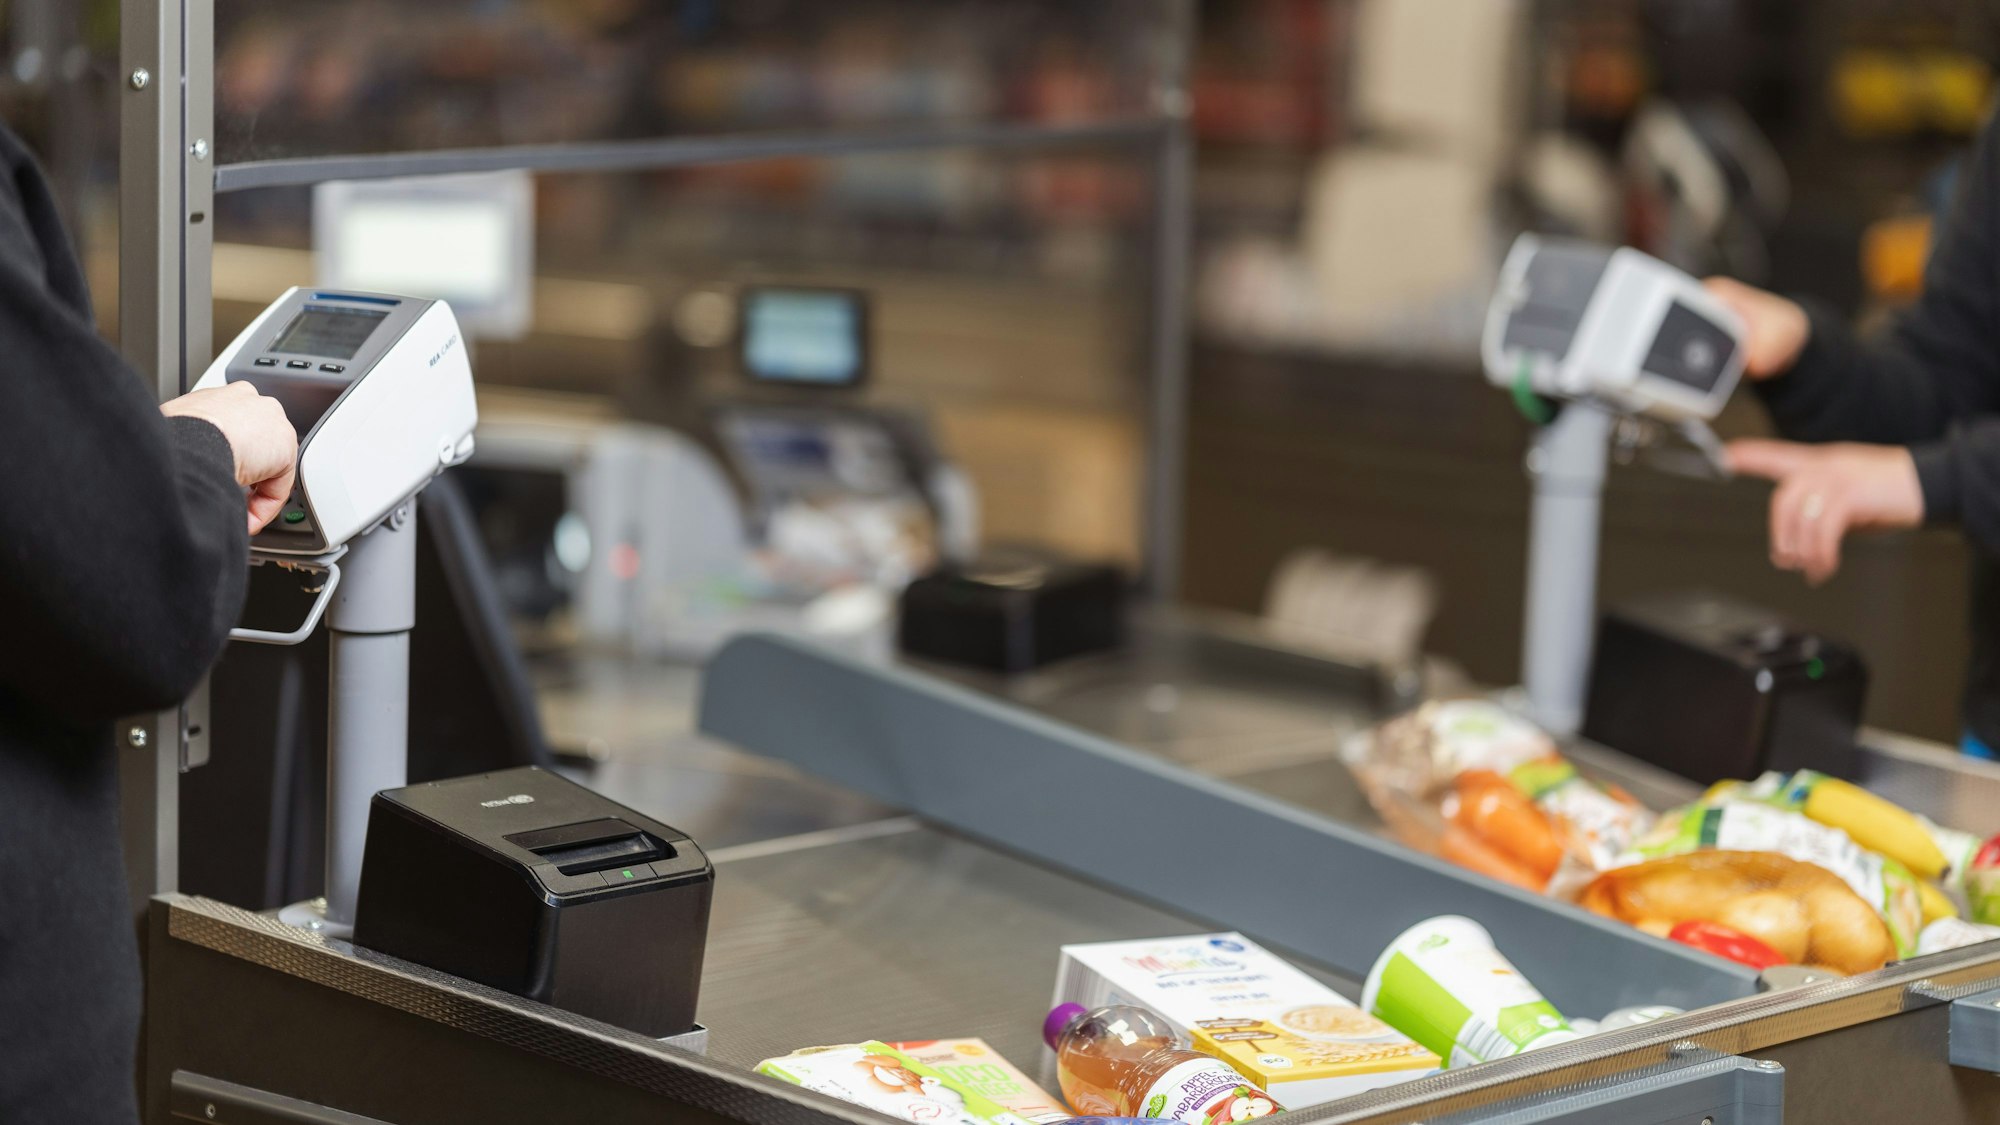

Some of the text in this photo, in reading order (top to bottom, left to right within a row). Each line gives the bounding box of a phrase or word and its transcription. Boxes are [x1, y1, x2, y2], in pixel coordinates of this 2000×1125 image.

[429, 352, 440, 367] REA
[939, 1064, 1010, 1084] OCO
[1180, 1071, 1217, 1093] APFEL-
